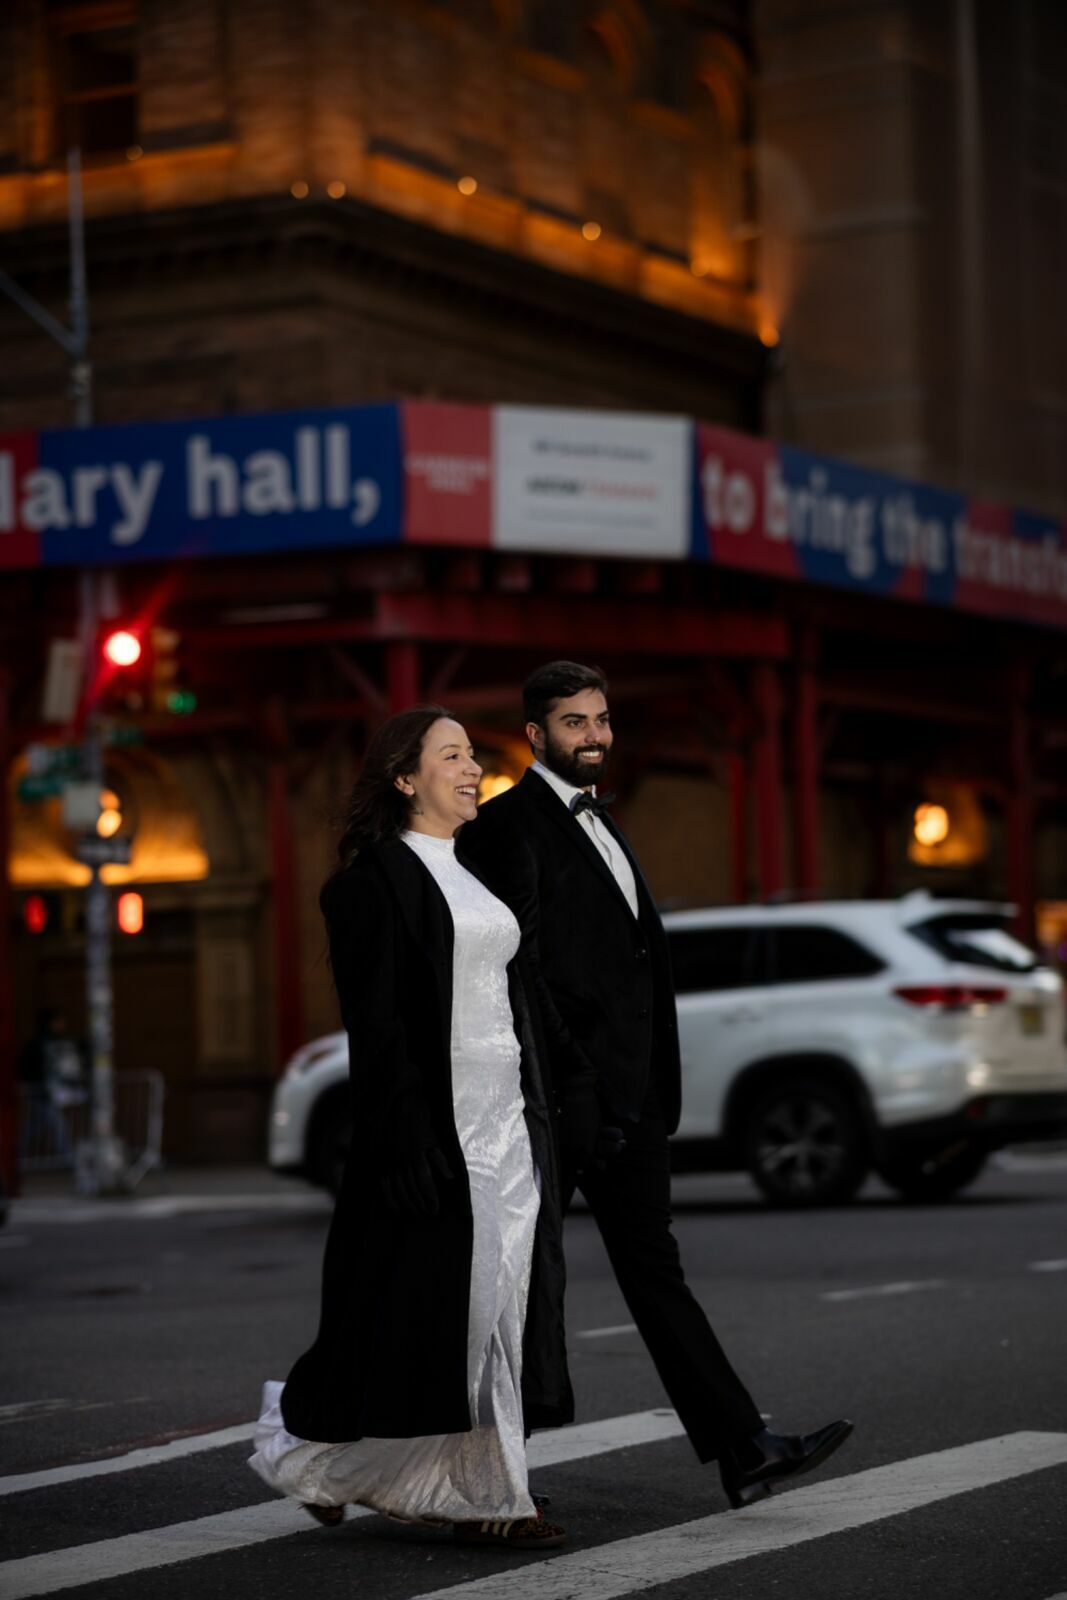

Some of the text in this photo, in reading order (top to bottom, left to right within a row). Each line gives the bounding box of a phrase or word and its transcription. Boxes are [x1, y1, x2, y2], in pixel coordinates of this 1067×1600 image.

[186, 422, 381, 526] hall,
[703, 454, 755, 534] to
[764, 460, 876, 579] bring
[882, 491, 947, 572] the
